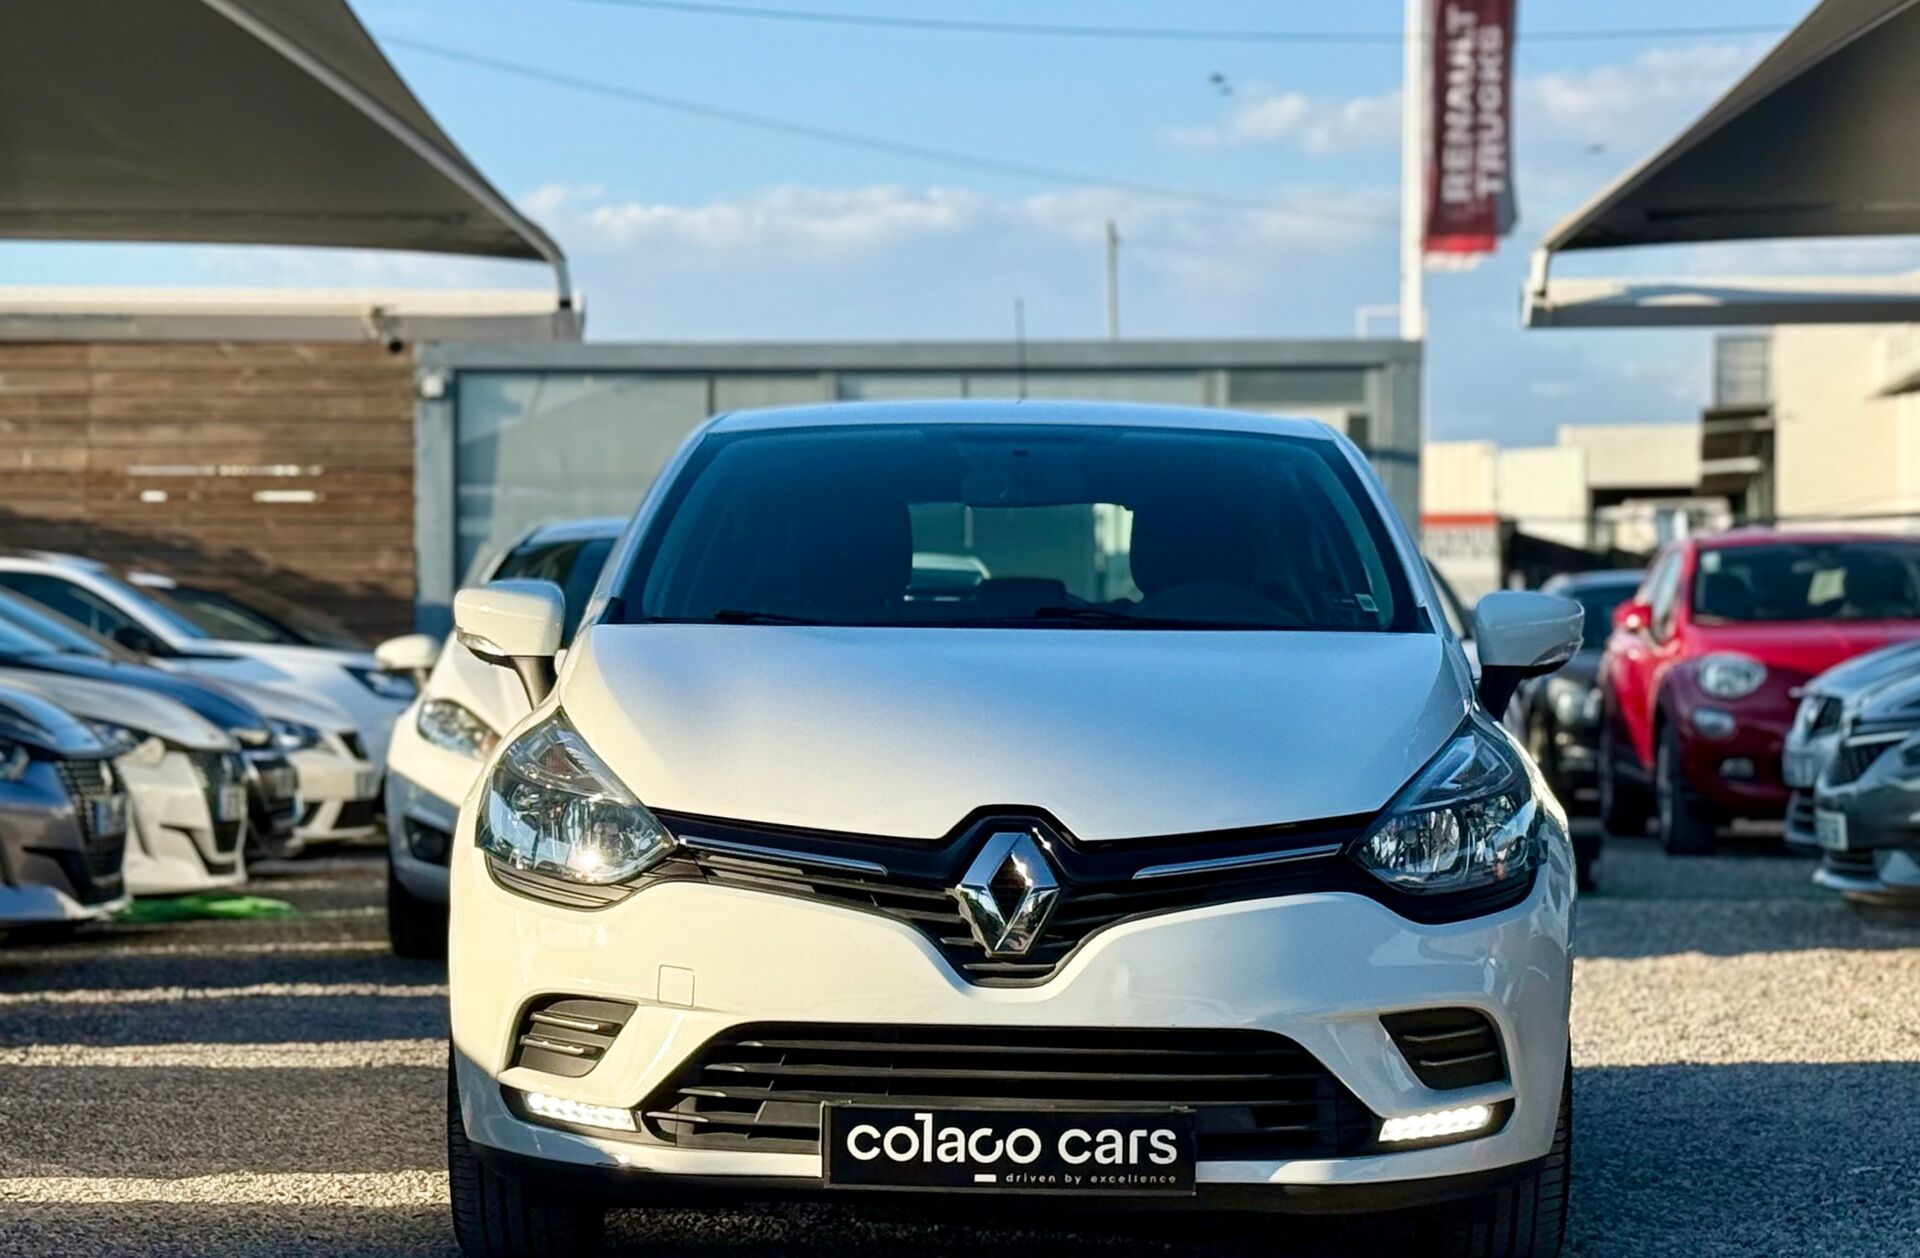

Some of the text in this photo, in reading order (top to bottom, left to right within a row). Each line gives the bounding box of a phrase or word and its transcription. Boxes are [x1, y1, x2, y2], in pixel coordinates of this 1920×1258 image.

[1057, 1128, 1177, 1164] cars
[1005, 1172, 1177, 1186] driven by excellence
